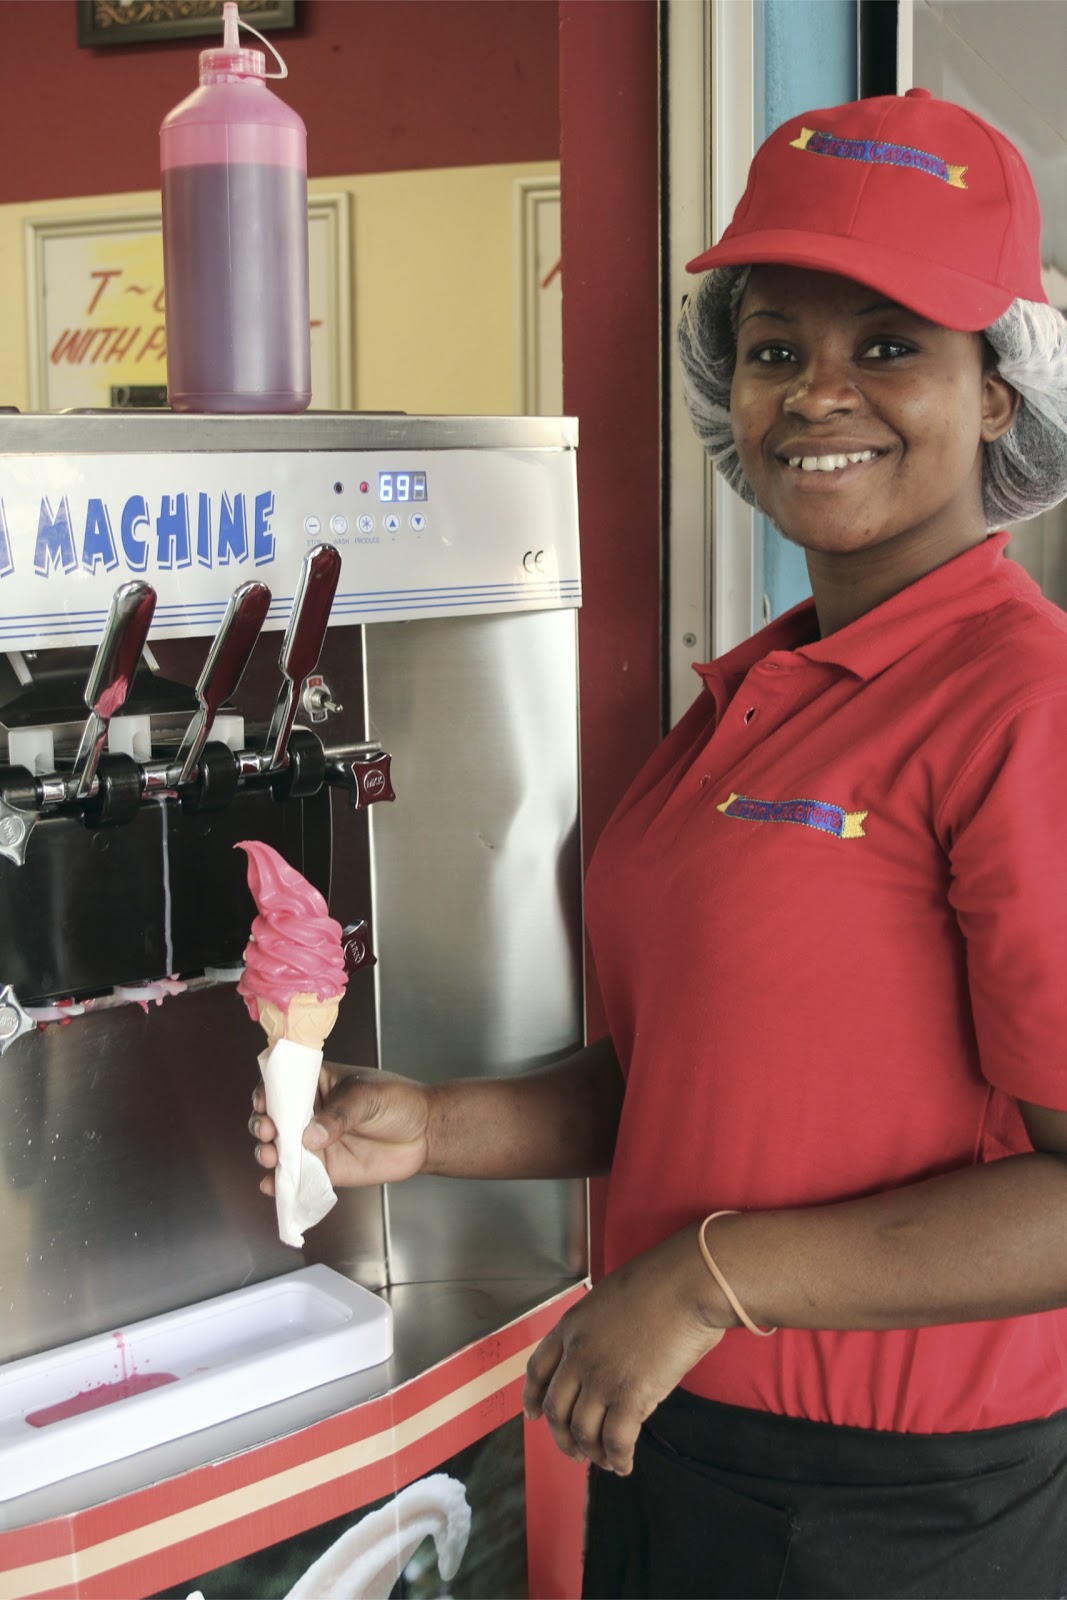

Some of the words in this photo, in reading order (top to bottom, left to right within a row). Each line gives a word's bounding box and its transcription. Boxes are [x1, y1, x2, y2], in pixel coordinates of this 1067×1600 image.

[869, 142, 947, 176] Caterers
[50, 326, 141, 365] WITH
[33, 489, 276, 578] MACHINE
[333, 537, 350, 545] WASH
[354, 536, 380, 544] PRODUCE
[769, 802, 842, 828] Caterers
